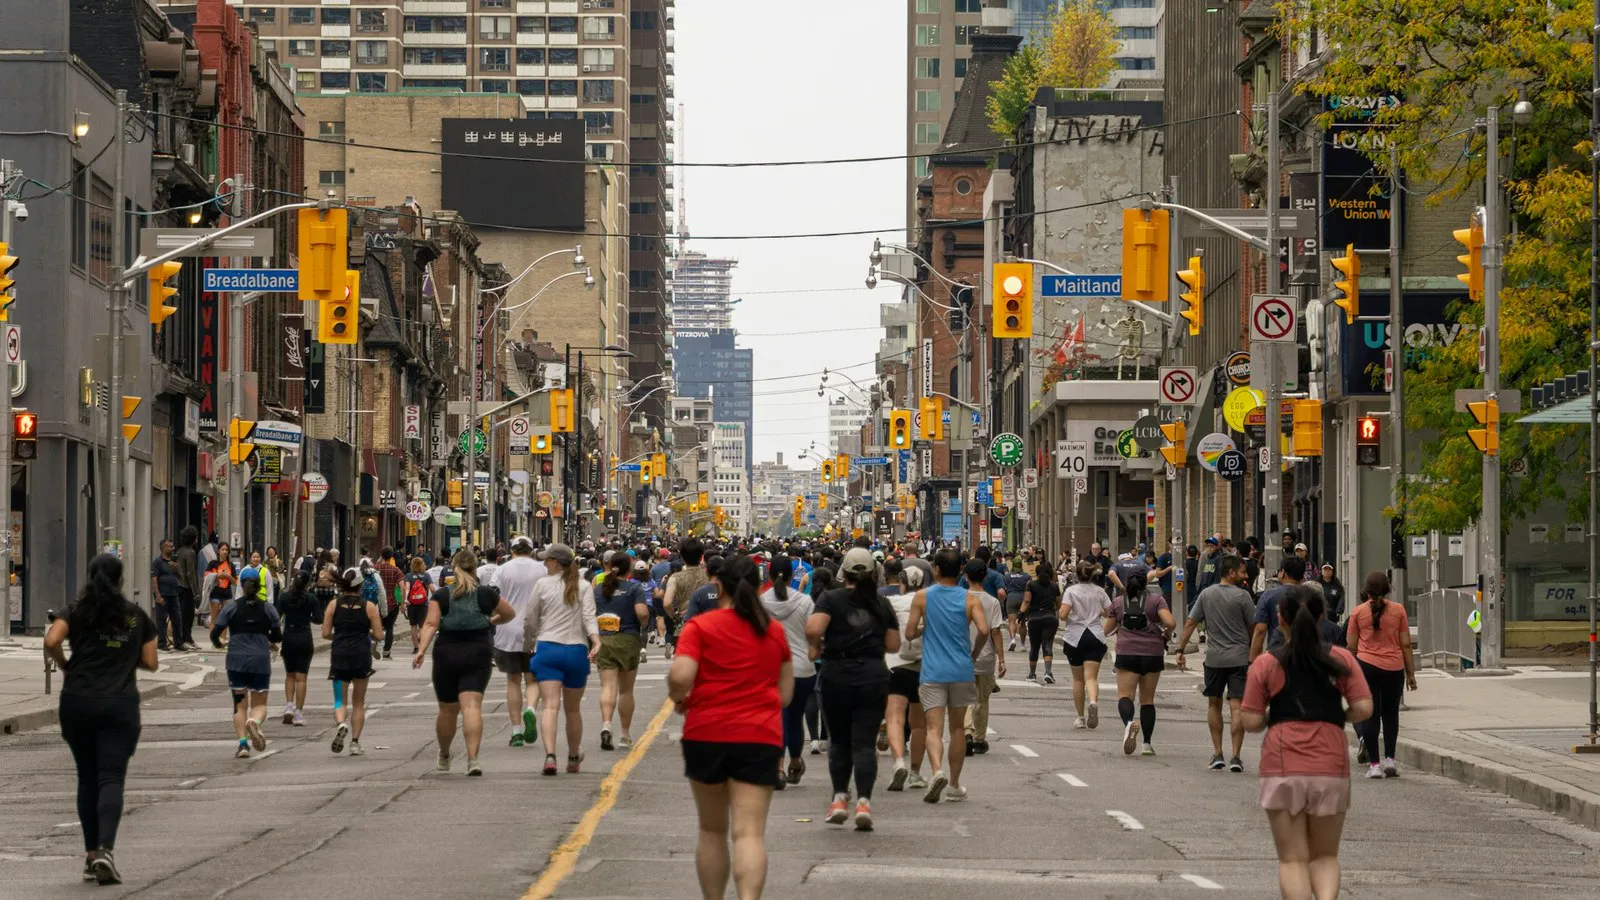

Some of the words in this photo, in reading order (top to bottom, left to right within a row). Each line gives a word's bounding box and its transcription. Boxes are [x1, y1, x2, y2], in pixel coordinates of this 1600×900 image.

[1328, 198, 1377, 209] Western
[1343, 208, 1377, 219] Union
[207, 273, 295, 288] Breadalbane
[1054, 278, 1120, 293] Maitland
[1230, 402, 1245, 410] EGG
[406, 405, 418, 433] SPA
[1160, 409, 1192, 421] LCO
[255, 430, 293, 440] Breadalbane
[293, 433, 300, 441] St
[992, 434, 1022, 448] MUNICIPAL
[1001, 442, 1015, 456] P
[992, 452, 1024, 466] PARKING
[1060, 456, 1085, 472] 40
[406, 505, 423, 514] SPA
[880, 516, 886, 524] 1
[1545, 588, 1576, 600] FOR
[1564, 604, 1587, 616] sq.ft
